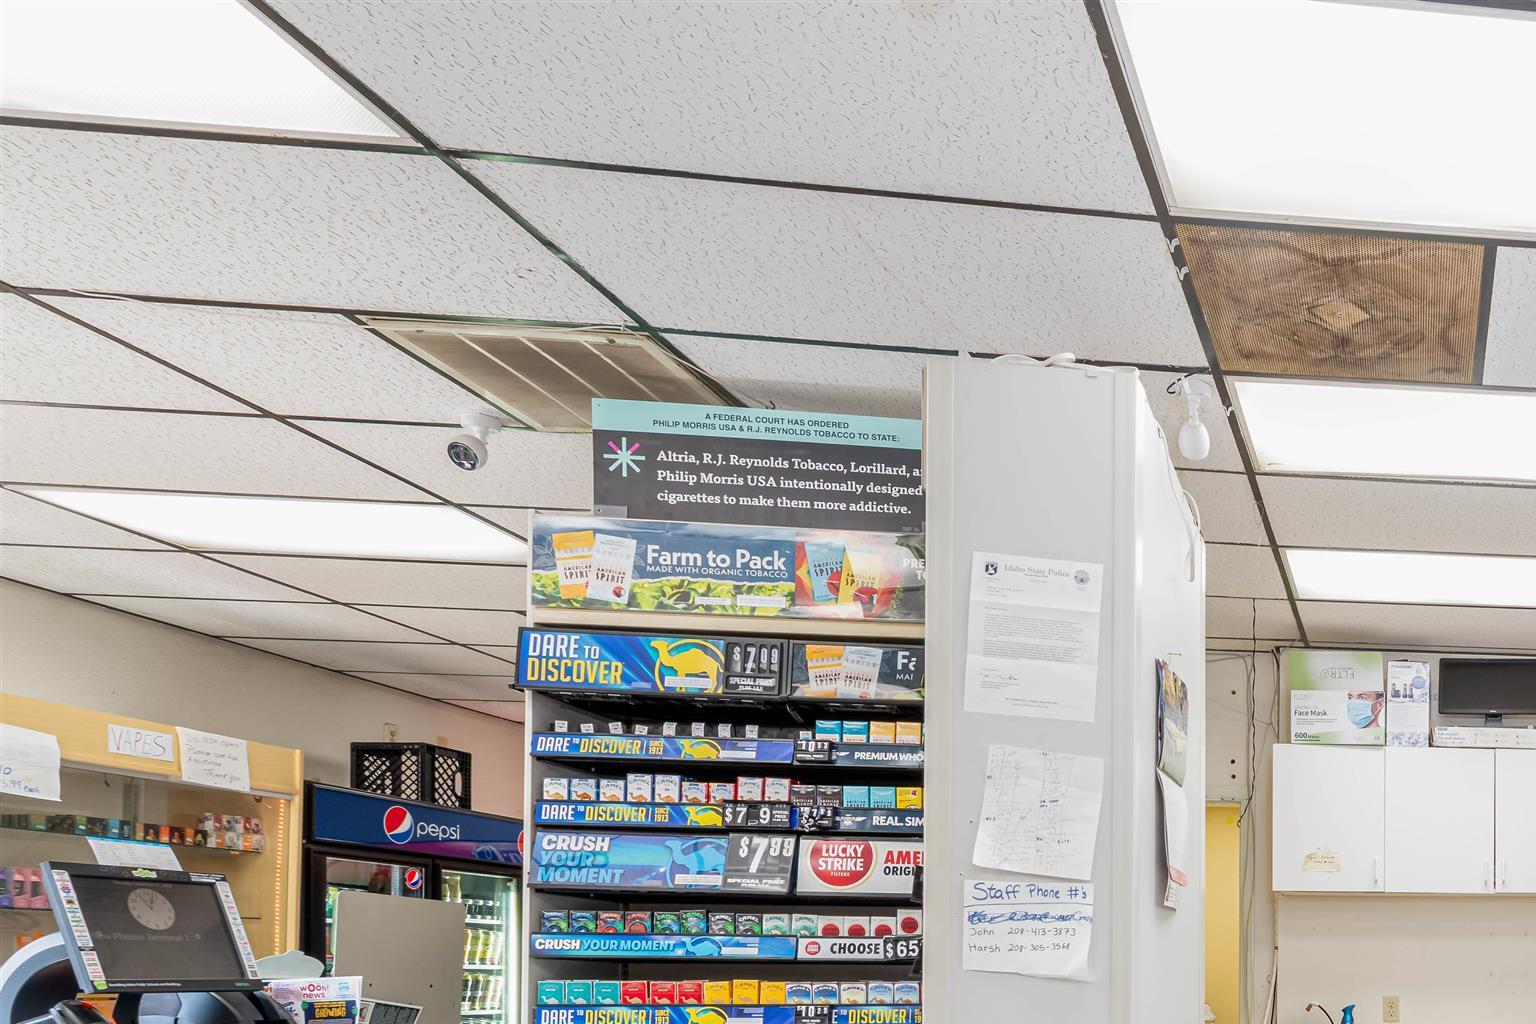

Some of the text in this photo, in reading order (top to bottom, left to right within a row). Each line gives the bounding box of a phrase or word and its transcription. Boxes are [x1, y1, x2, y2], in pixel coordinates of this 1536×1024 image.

[705, 413, 850, 429] A FEDERAL COURT HAS ORDERED
[653, 419, 901, 443] PHILIP MORRIS USA & R.J. REYNOLDS TOBACCO TO STATE:
[657, 450, 700, 466] Altria,
[702, 452, 727, 466] R.J.
[729, 454, 791, 469] Reynolds
[792, 458, 848, 474] Tobacco,
[850, 461, 911, 478] Lorillard,
[657, 470, 924, 498] Philip Morris USA intentionally designed
[657, 490, 912, 514] cigarettes to make them more addictive.
[646, 544, 787, 571] Farm to Pack
[646, 565, 788, 579] MADE WITH ORGANIC TOBACCO
[1004, 563, 1070, 578] Idaho State Police
[528, 633, 600, 660] DARE TO
[526, 657, 624, 685] DISCOVER
[1294, 709, 1328, 718] Face Mask
[110, 726, 166, 757] VAPES
[1294, 731, 1308, 740] 600
[537, 736, 571, 753] DARE
[572, 737, 580, 745] TO
[579, 738, 641, 755] DISCOVER
[853, 751, 900, 761] PREMIUM
[541, 804, 575, 821] DARE
[584, 805, 646, 823] DISCOVER
[872, 816, 904, 826] REAL.
[416, 821, 460, 841] pepsi
[542, 834, 611, 852] CRUSH
[821, 843, 865, 858] LUCKY
[540, 850, 596, 867] YOUR
[818, 857, 865, 873] STRIKE
[537, 866, 625, 884] MOMENT
[971, 881, 1021, 901] Staff
[1026, 883, 1060, 899] Phone
[969, 926, 1076, 938] John 208-413-3873
[535, 939, 677, 952] CRUSH YOUR MOMENT
[829, 942, 881, 955] CHOOSE
[968, 943, 1001, 953] Harsh
[303, 991, 326, 1000] news
[848, 1008, 906, 1024] DISCOVER
